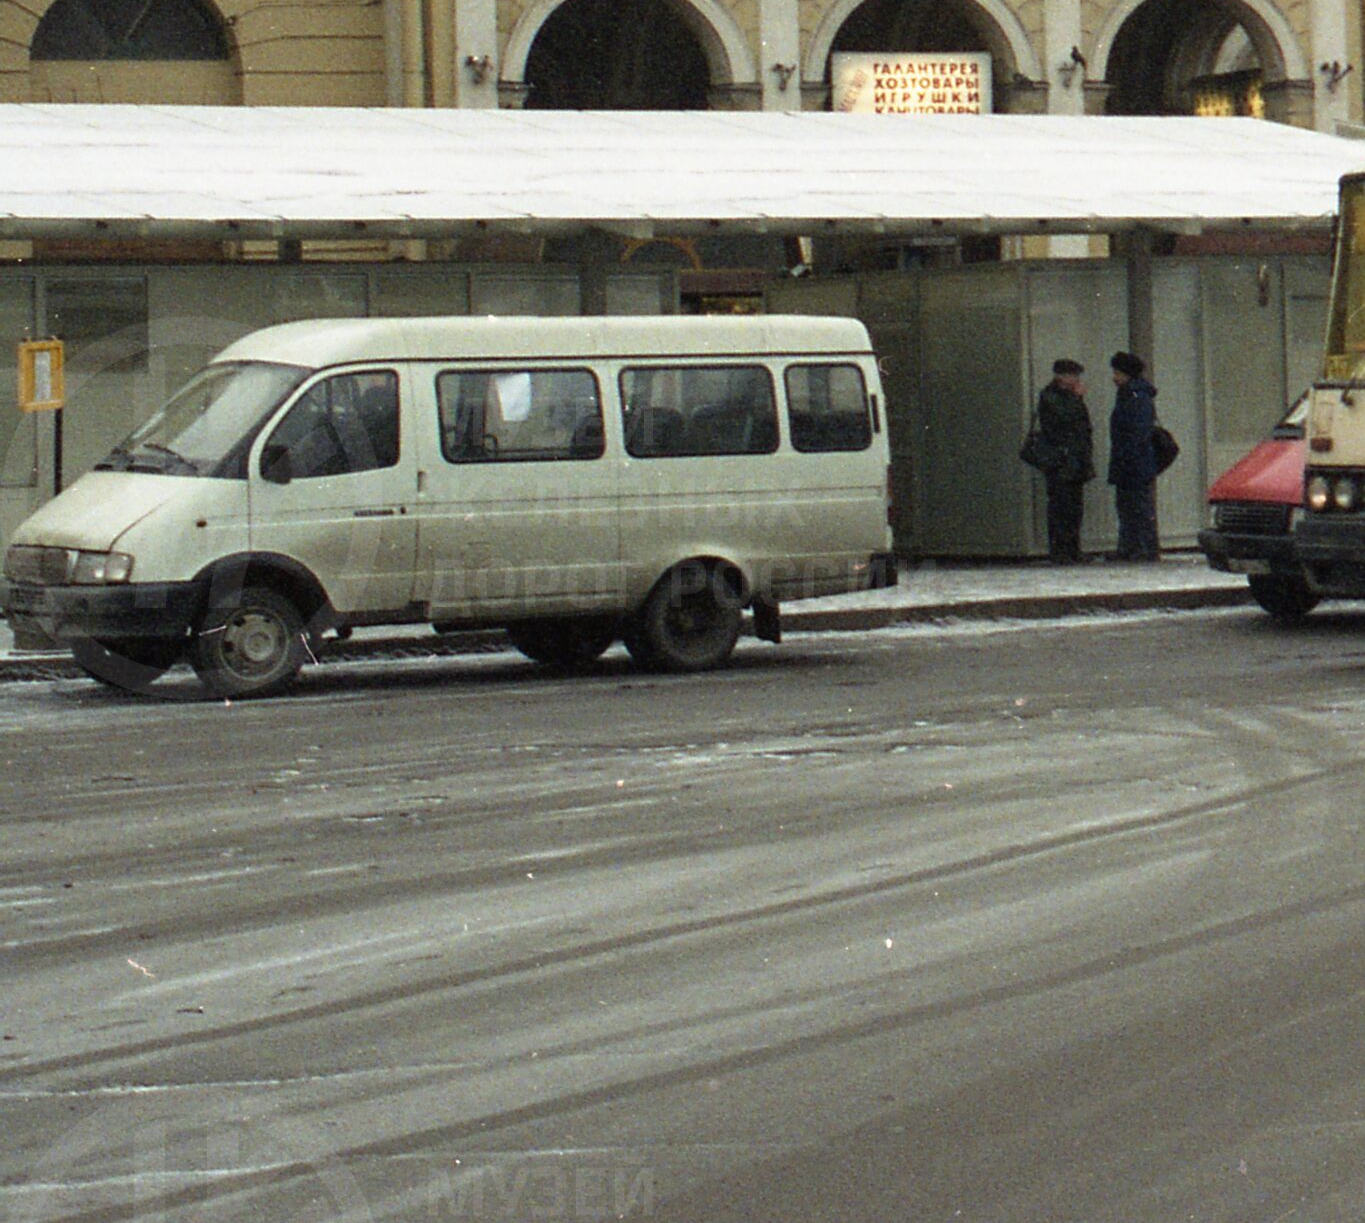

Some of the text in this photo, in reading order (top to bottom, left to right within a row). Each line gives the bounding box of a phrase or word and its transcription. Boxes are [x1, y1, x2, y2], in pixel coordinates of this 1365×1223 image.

[873, 63, 979, 74] ГАЛАНТЕРЕЯ
[874, 78, 980, 90] ХОЗТОВАРЫ
[874, 92, 980, 104] ИГРУШКИ
